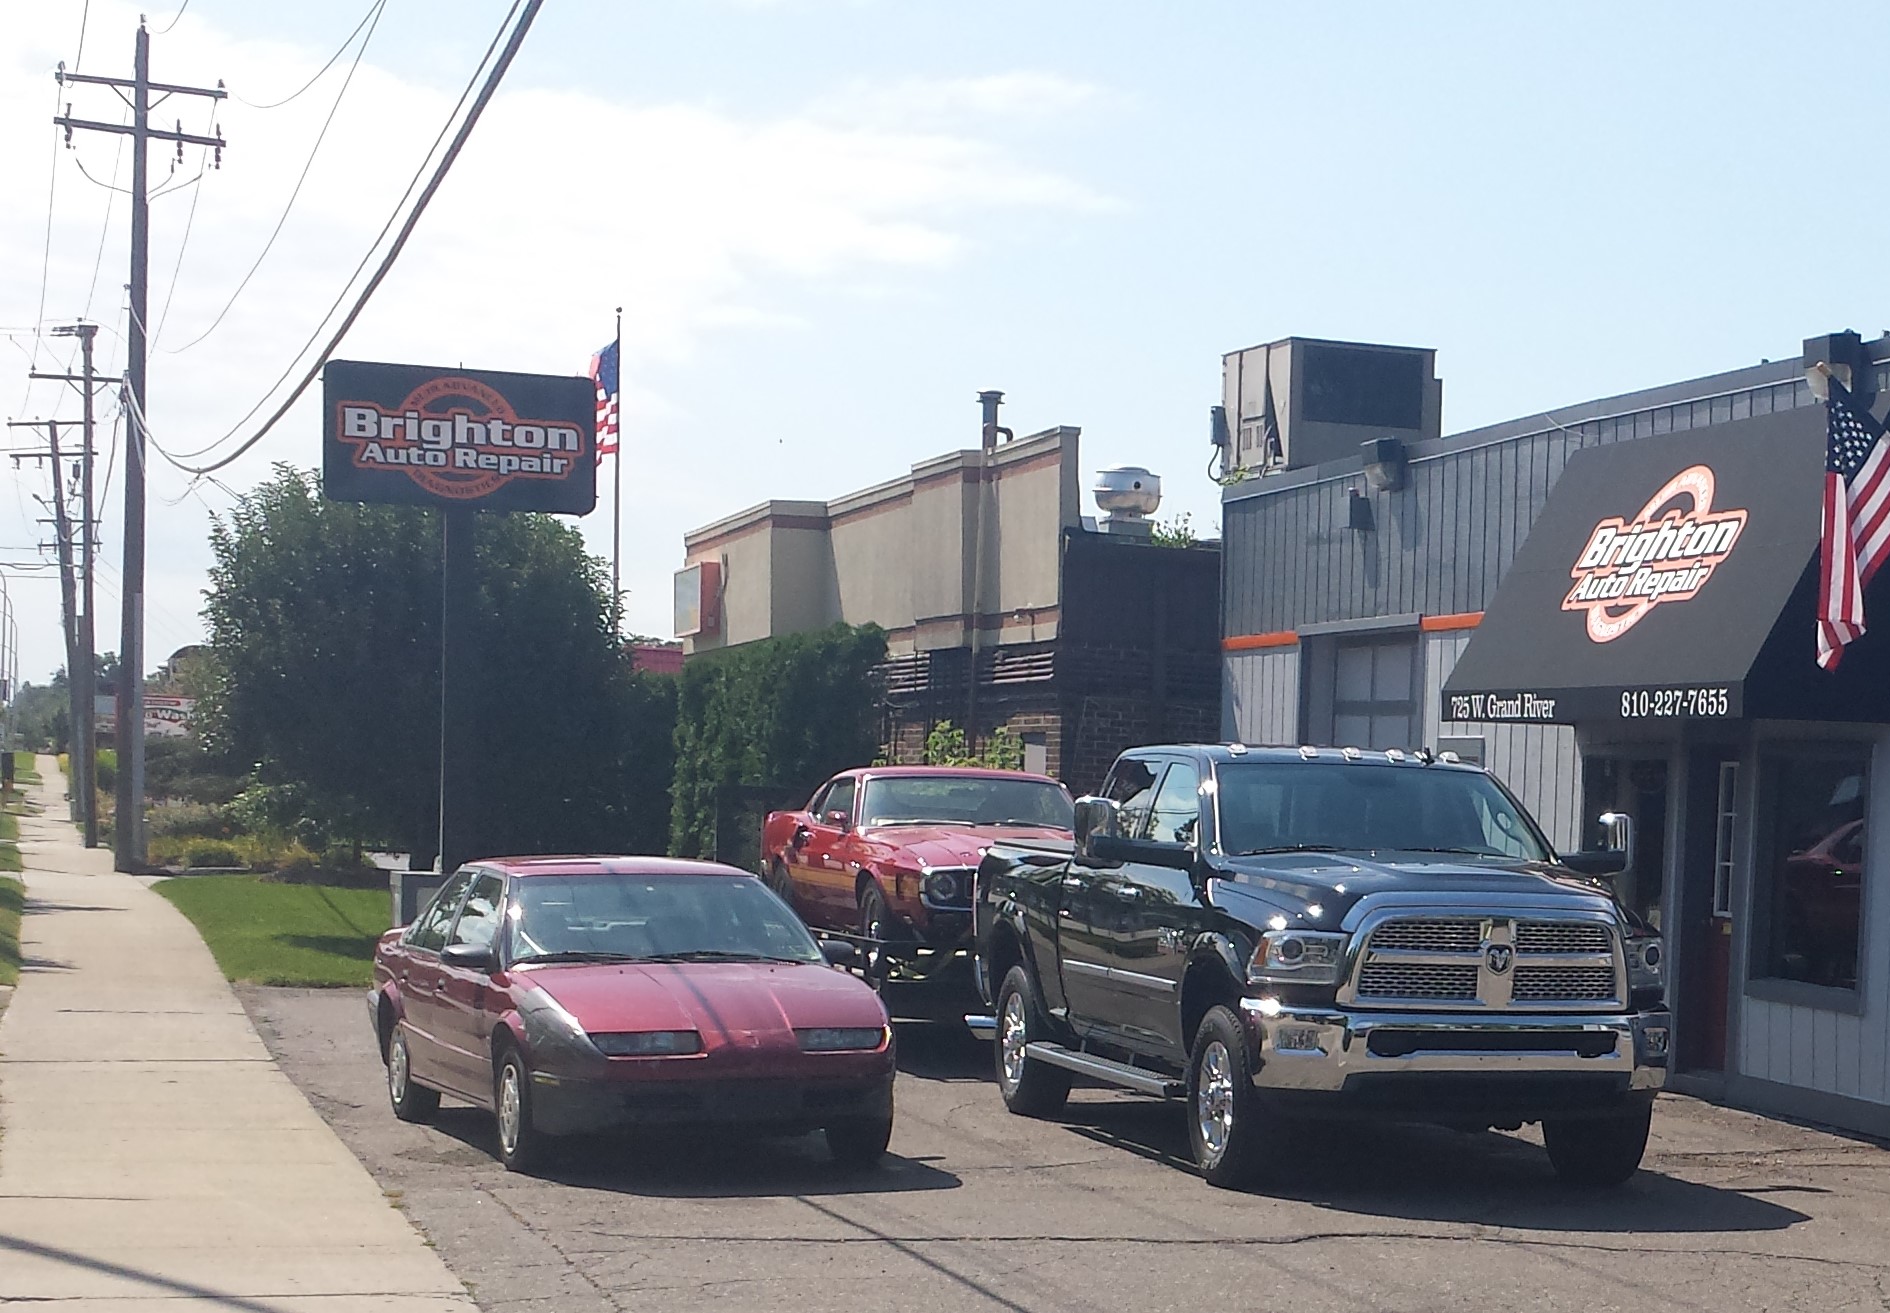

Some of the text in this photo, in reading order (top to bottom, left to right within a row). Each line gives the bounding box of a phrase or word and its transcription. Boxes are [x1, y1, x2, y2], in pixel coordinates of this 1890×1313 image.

[343, 406, 579, 451] Brighton
[360, 443, 568, 476] Auto Repair
[1578, 519, 1741, 575] Brighton
[1569, 561, 1709, 601] Auto Repair
[1451, 693, 1555, 719] 725 W. Grand River
[1621, 688, 1729, 718] 810-227-7655
